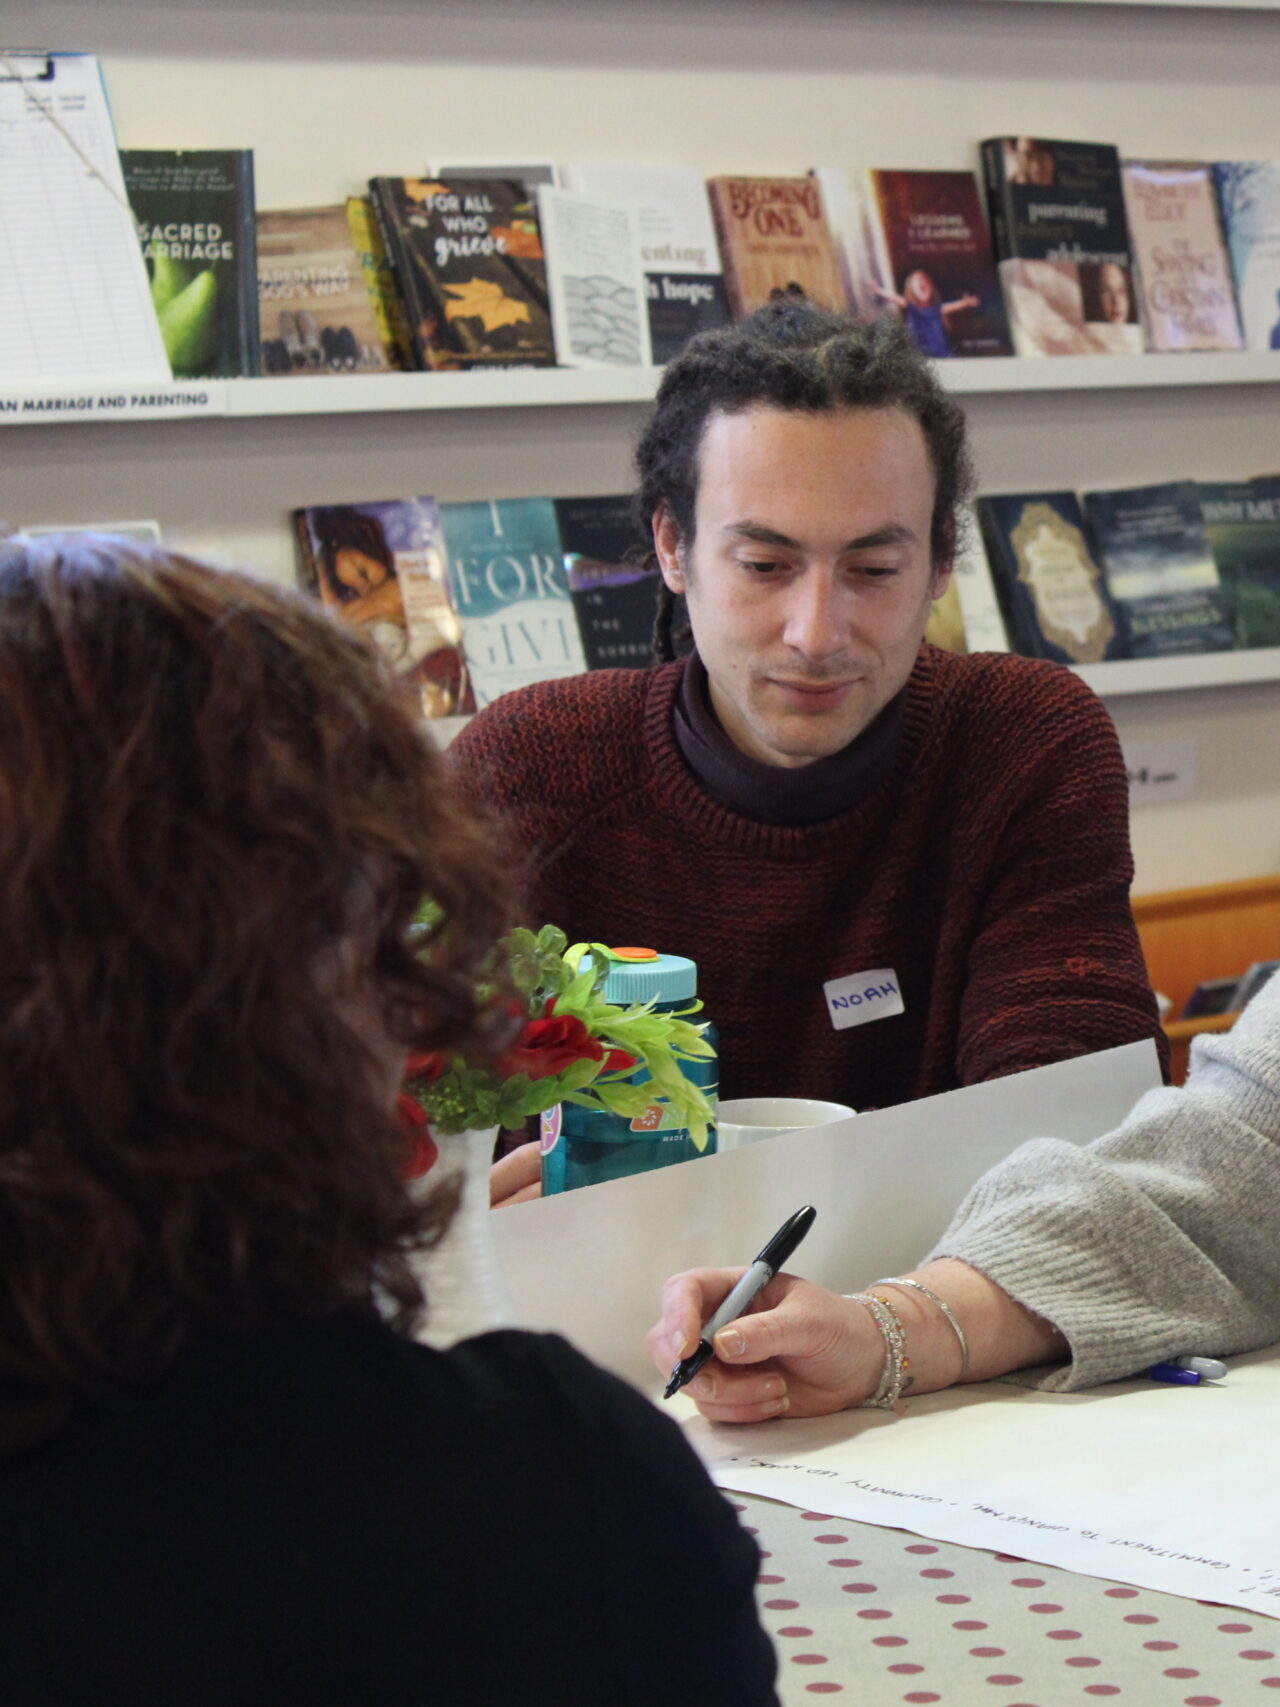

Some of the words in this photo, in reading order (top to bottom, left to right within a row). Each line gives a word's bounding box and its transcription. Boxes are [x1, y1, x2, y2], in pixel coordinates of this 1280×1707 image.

[424, 193, 460, 213] FOR
[464, 193, 494, 213] ALL
[137, 223, 222, 241] SACRED
[441, 215, 488, 233] WHO
[142, 241, 235, 260] ARRIAGE
[434, 234, 507, 267] grieve
[640, 243, 706, 267] enting
[0, 400, 18, 412] AN
[22, 397, 94, 411] MARRIAGE
[97, 396, 126, 409] AND
[130, 392, 209, 407] PARENTING
[454, 553, 567, 604] FOR
[597, 643, 653, 658] SORRO
[831, 981, 898, 1010] NOAH
[662, 1134, 684, 1143] MADE
[1080, 1529, 1099, 1541] TO
[1106, 1537, 1232, 1570] COMMITMENT
